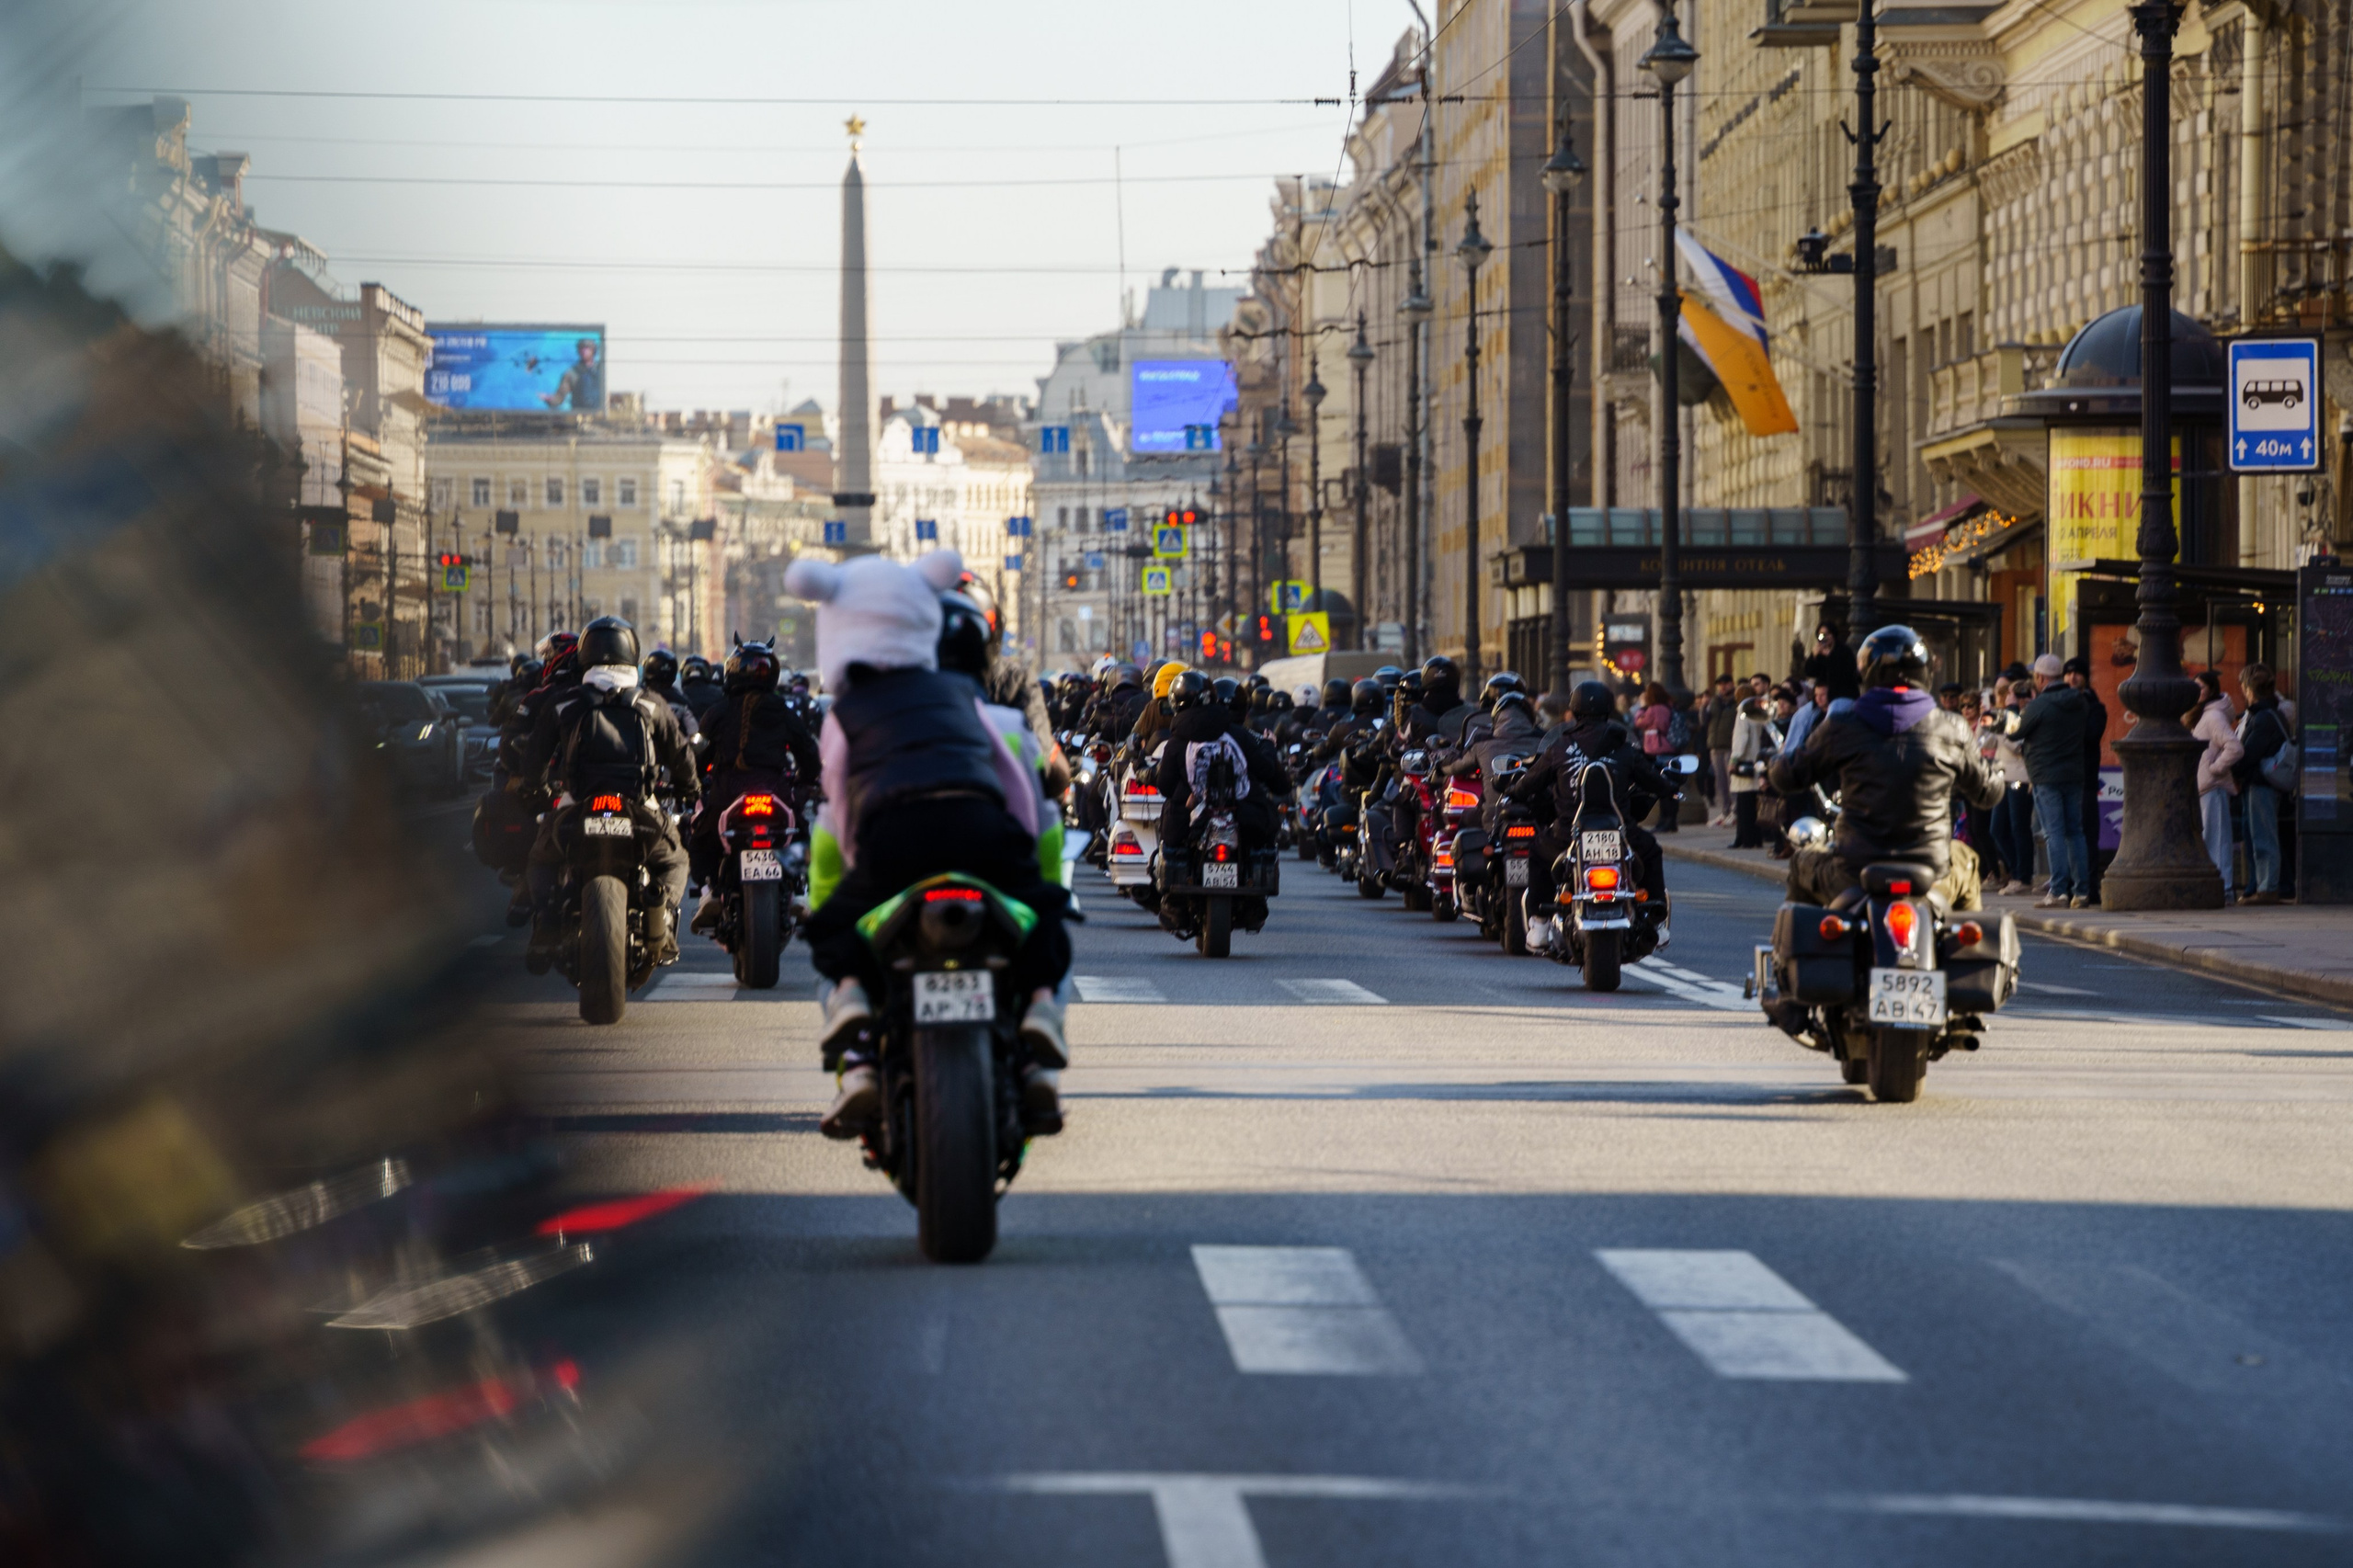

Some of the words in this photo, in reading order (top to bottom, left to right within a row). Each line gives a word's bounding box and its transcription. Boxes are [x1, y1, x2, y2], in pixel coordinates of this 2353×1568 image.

[2060, 491, 2143, 519] ИКНИ
[2068, 527, 2118, 540] АПРЕЛЯ
[1734, 558, 1786, 573] ОТЕЛЬ
[1587, 833, 1615, 844] 2180
[1585, 848, 1601, 860] АН
[1606, 847, 1619, 859] 18
[765, 867, 779, 877] 66
[1883, 974, 1932, 994] 5892
[1875, 1000, 1904, 1017] АВ
[1915, 1003, 1938, 1019] 47
